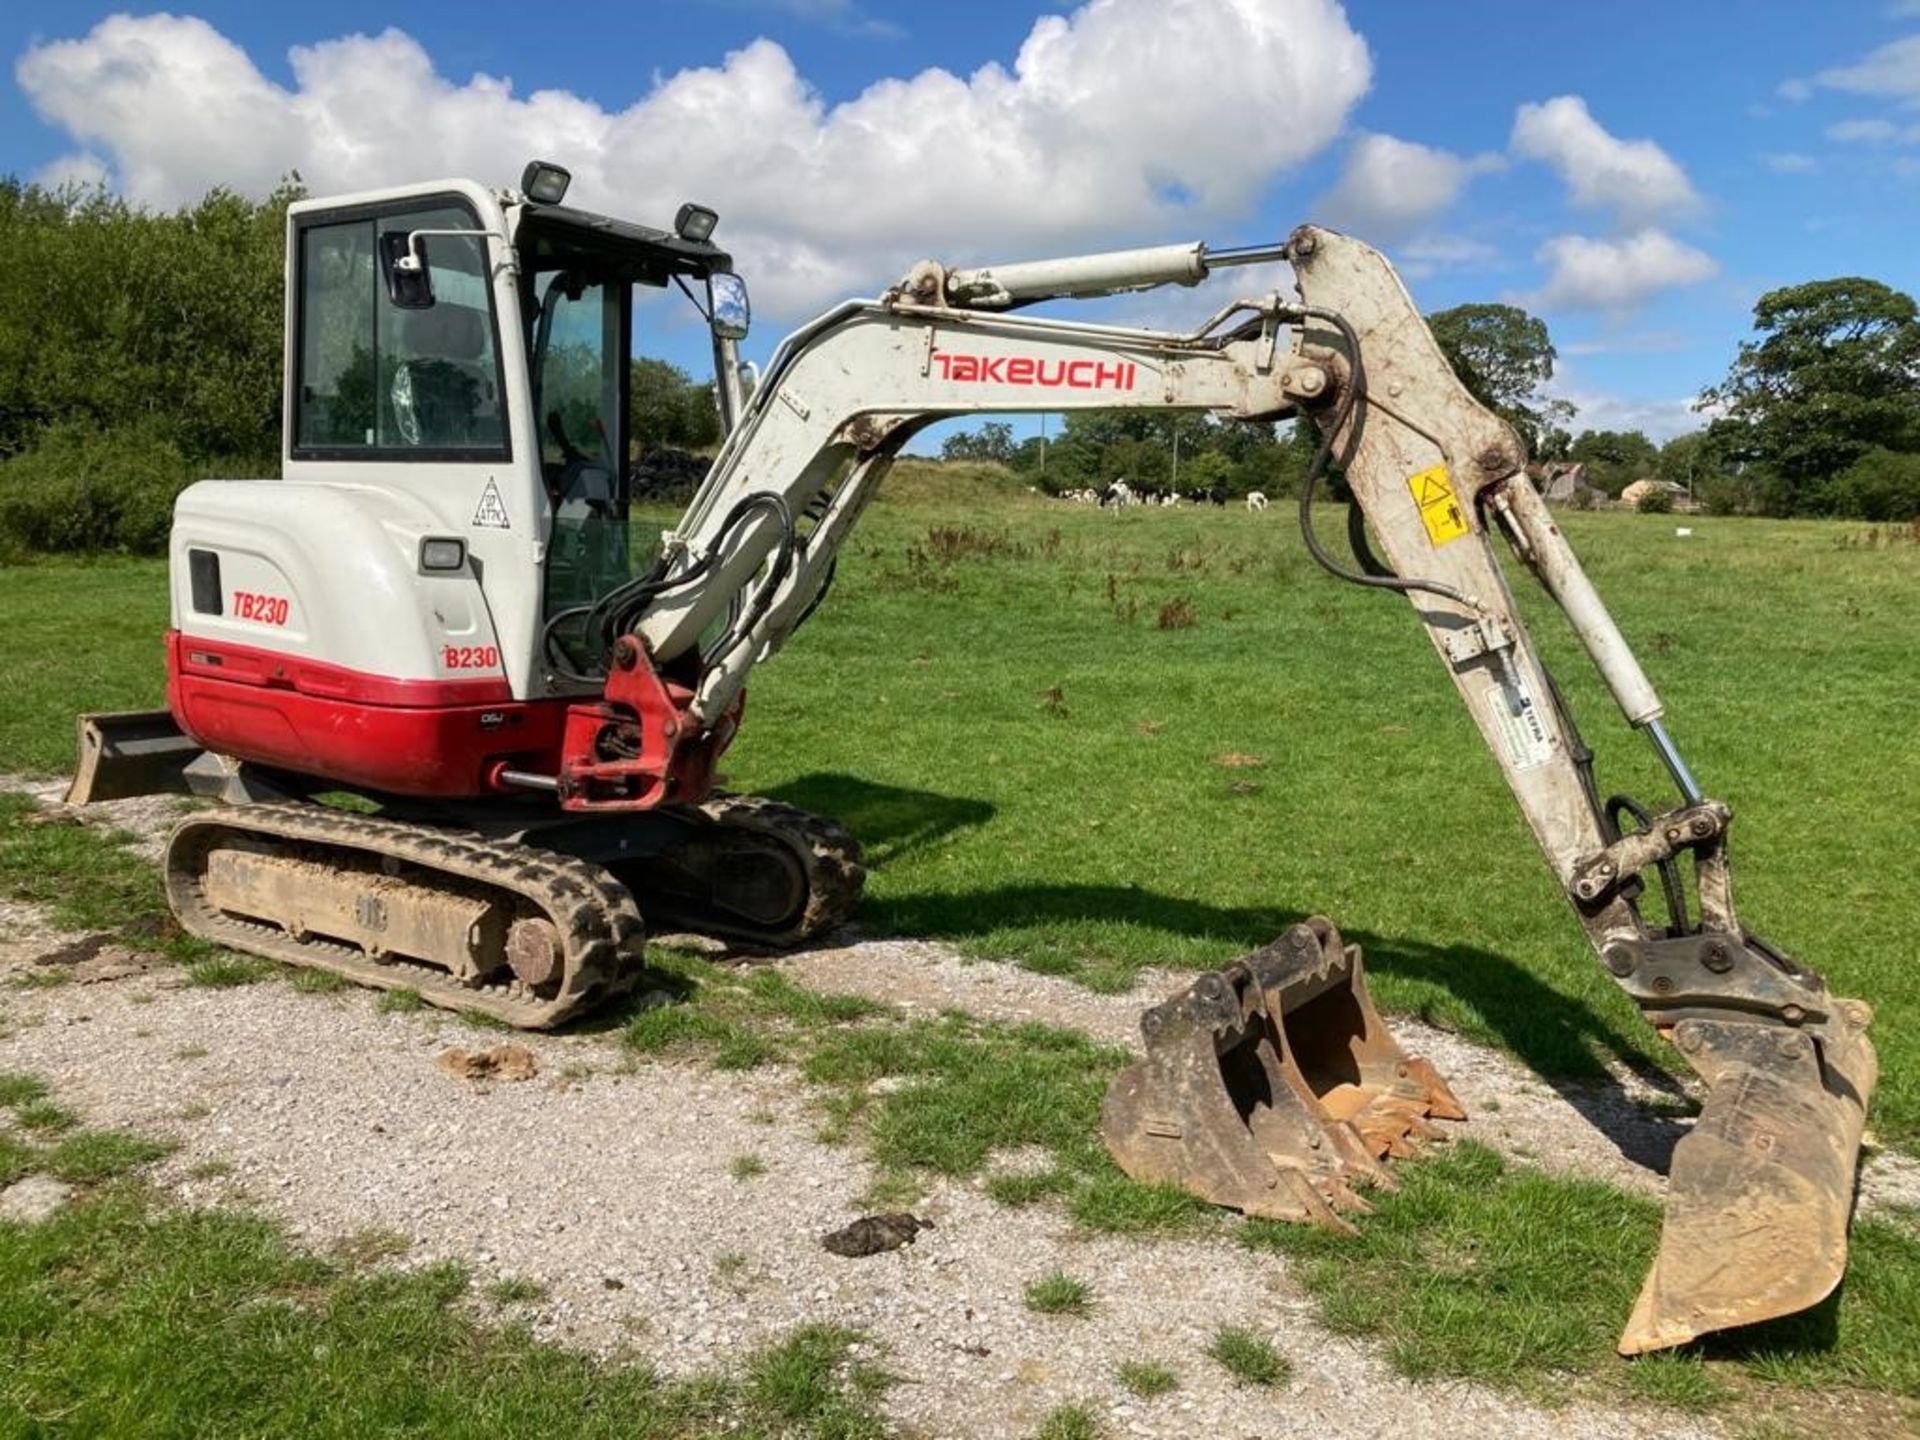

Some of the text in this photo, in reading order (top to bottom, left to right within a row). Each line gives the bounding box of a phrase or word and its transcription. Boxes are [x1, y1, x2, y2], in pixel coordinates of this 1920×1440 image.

[933, 353, 1137, 391] TAKEUCHI
[233, 591, 289, 626] TB230
[440, 644, 498, 669] B230
